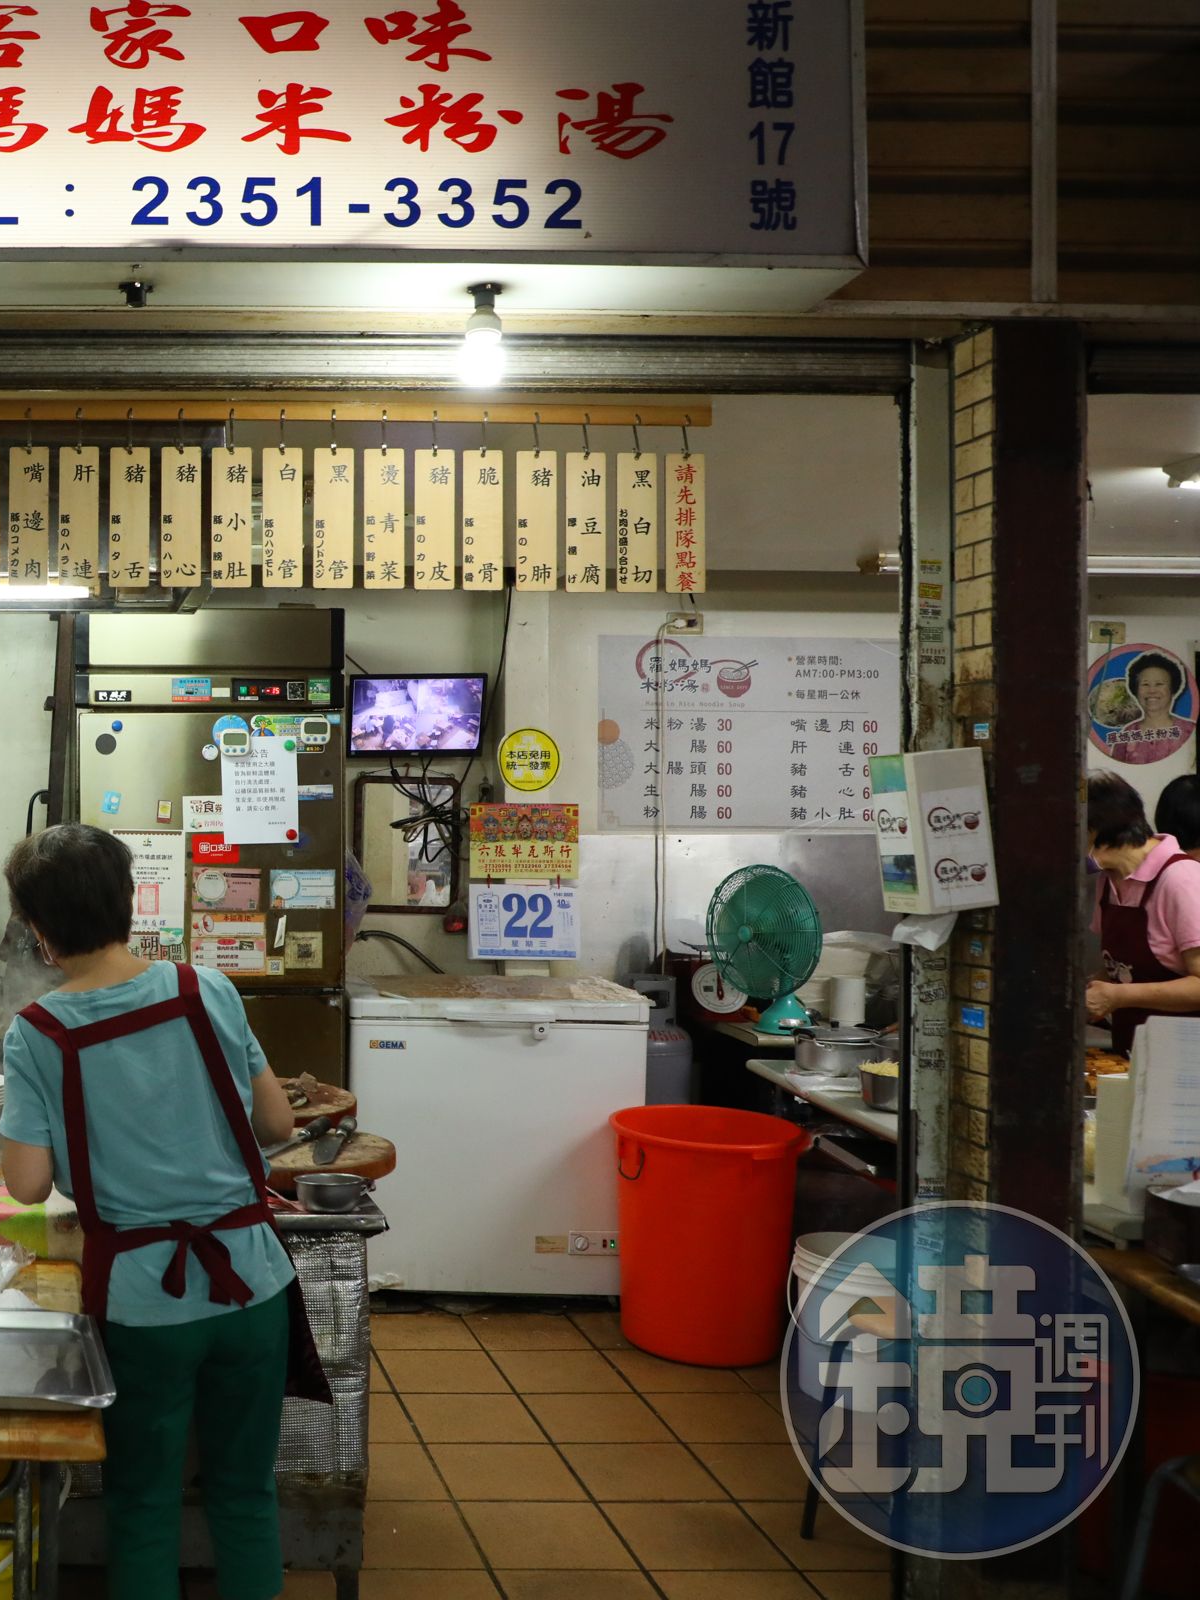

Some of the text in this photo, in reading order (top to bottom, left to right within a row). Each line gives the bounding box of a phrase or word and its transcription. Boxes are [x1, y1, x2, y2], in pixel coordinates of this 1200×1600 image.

[746, 0, 797, 232] 新館17號
[131, 176, 584, 230] 2351-3352
[23, 463, 45, 578] 嘴邊肉
[72, 463, 95, 579] 肝連
[124, 463, 147, 580] 豬舌
[175, 463, 198, 578] 豬心
[225, 463, 249, 578] 豬小肚
[278, 463, 298, 579] 白管
[328, 464, 350, 580] 黑管
[380, 464, 400, 581] 燙青菜
[429, 465, 451, 581] 豬皮
[477, 467, 499, 583] 脆骨
[531, 467, 553, 584] 豬肺
[580, 468, 602, 585] 油豆腐
[632, 469, 652, 584] 黑白切
[675, 464, 696, 592] 請先排隊點餐
[795, 669, 880, 679] AM7:00-PM3:00
[795, 690, 861, 700] 每星期一公休
[644, 717, 733, 732] 米粉湯 30
[791, 719, 878, 733] 嘴邊肉 60
[1106, 727, 1180, 744] 羅媽媽米粉湯
[250, 749, 269, 758] 公告
[506, 750, 551, 760] 本店免用
[644, 740, 733, 753] 大腸 60
[791, 741, 878, 755] 肝連 60
[506, 761, 551, 771] 統一發票
[644, 761, 733, 775] 大腸頭 60
[791, 763, 855, 777] 豬舌
[644, 783, 733, 798] 生腸 60
[791, 785, 855, 798] 豬心
[644, 805, 733, 820] 粉腸 60
[791, 807, 855, 821] 豬小肚
[502, 893, 553, 938] 22
[379, 1041, 405, 1049] GEMA
